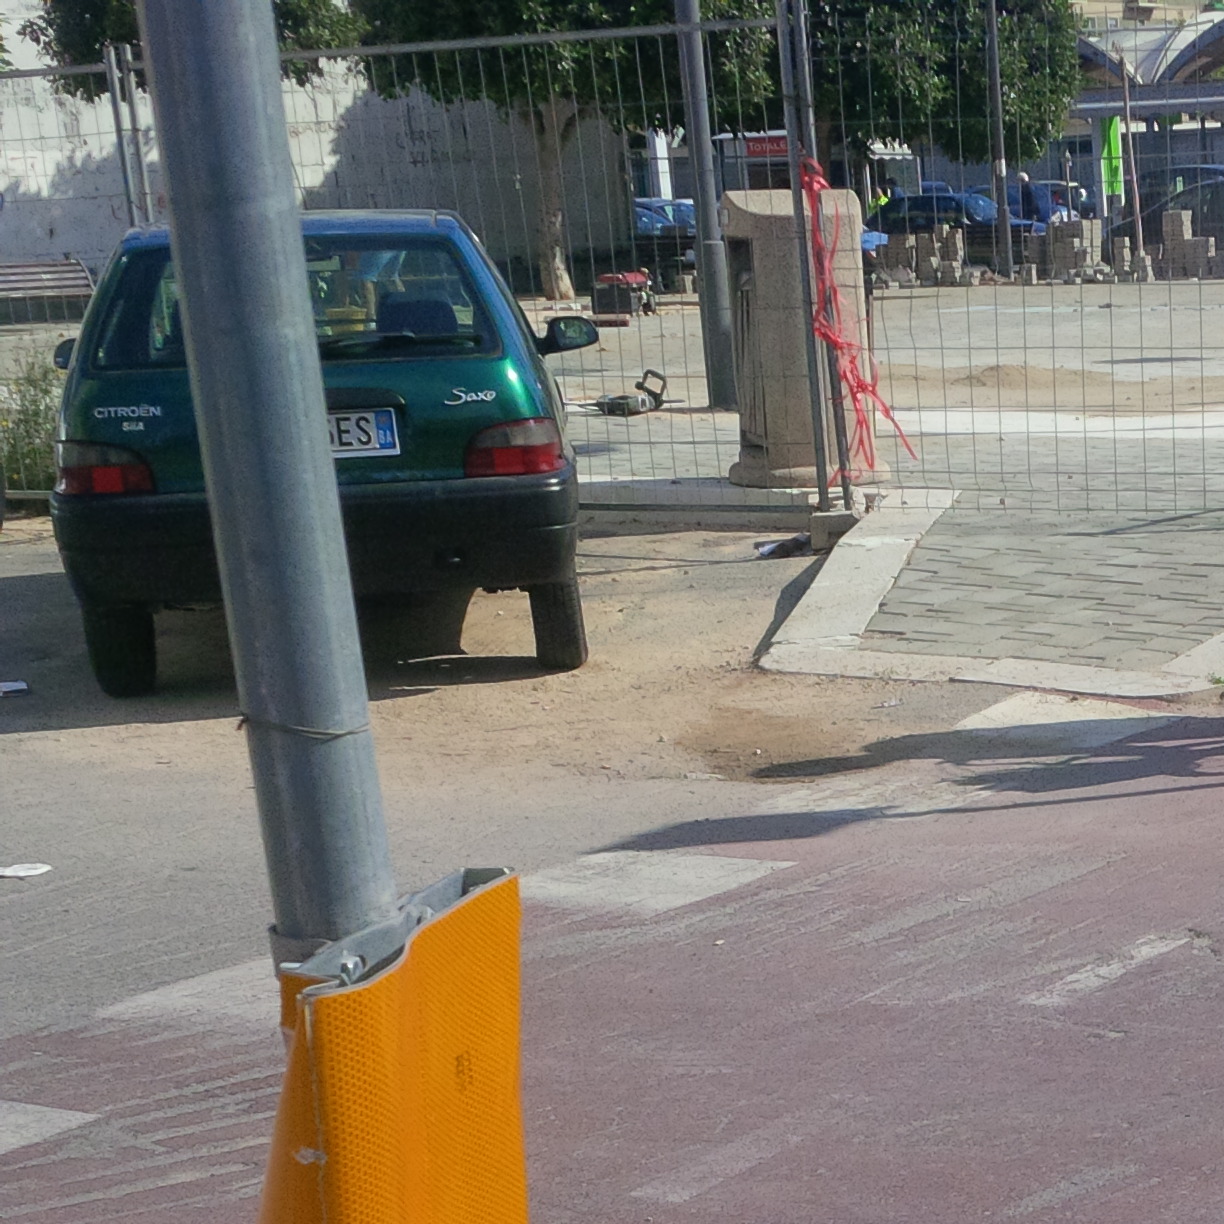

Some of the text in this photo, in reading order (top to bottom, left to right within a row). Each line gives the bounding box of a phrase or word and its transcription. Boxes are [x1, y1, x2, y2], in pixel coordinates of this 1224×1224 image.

[444, 387, 496, 405] Saxo
[94, 404, 161, 418] CITROËN
[328, 416, 372, 446] ES
